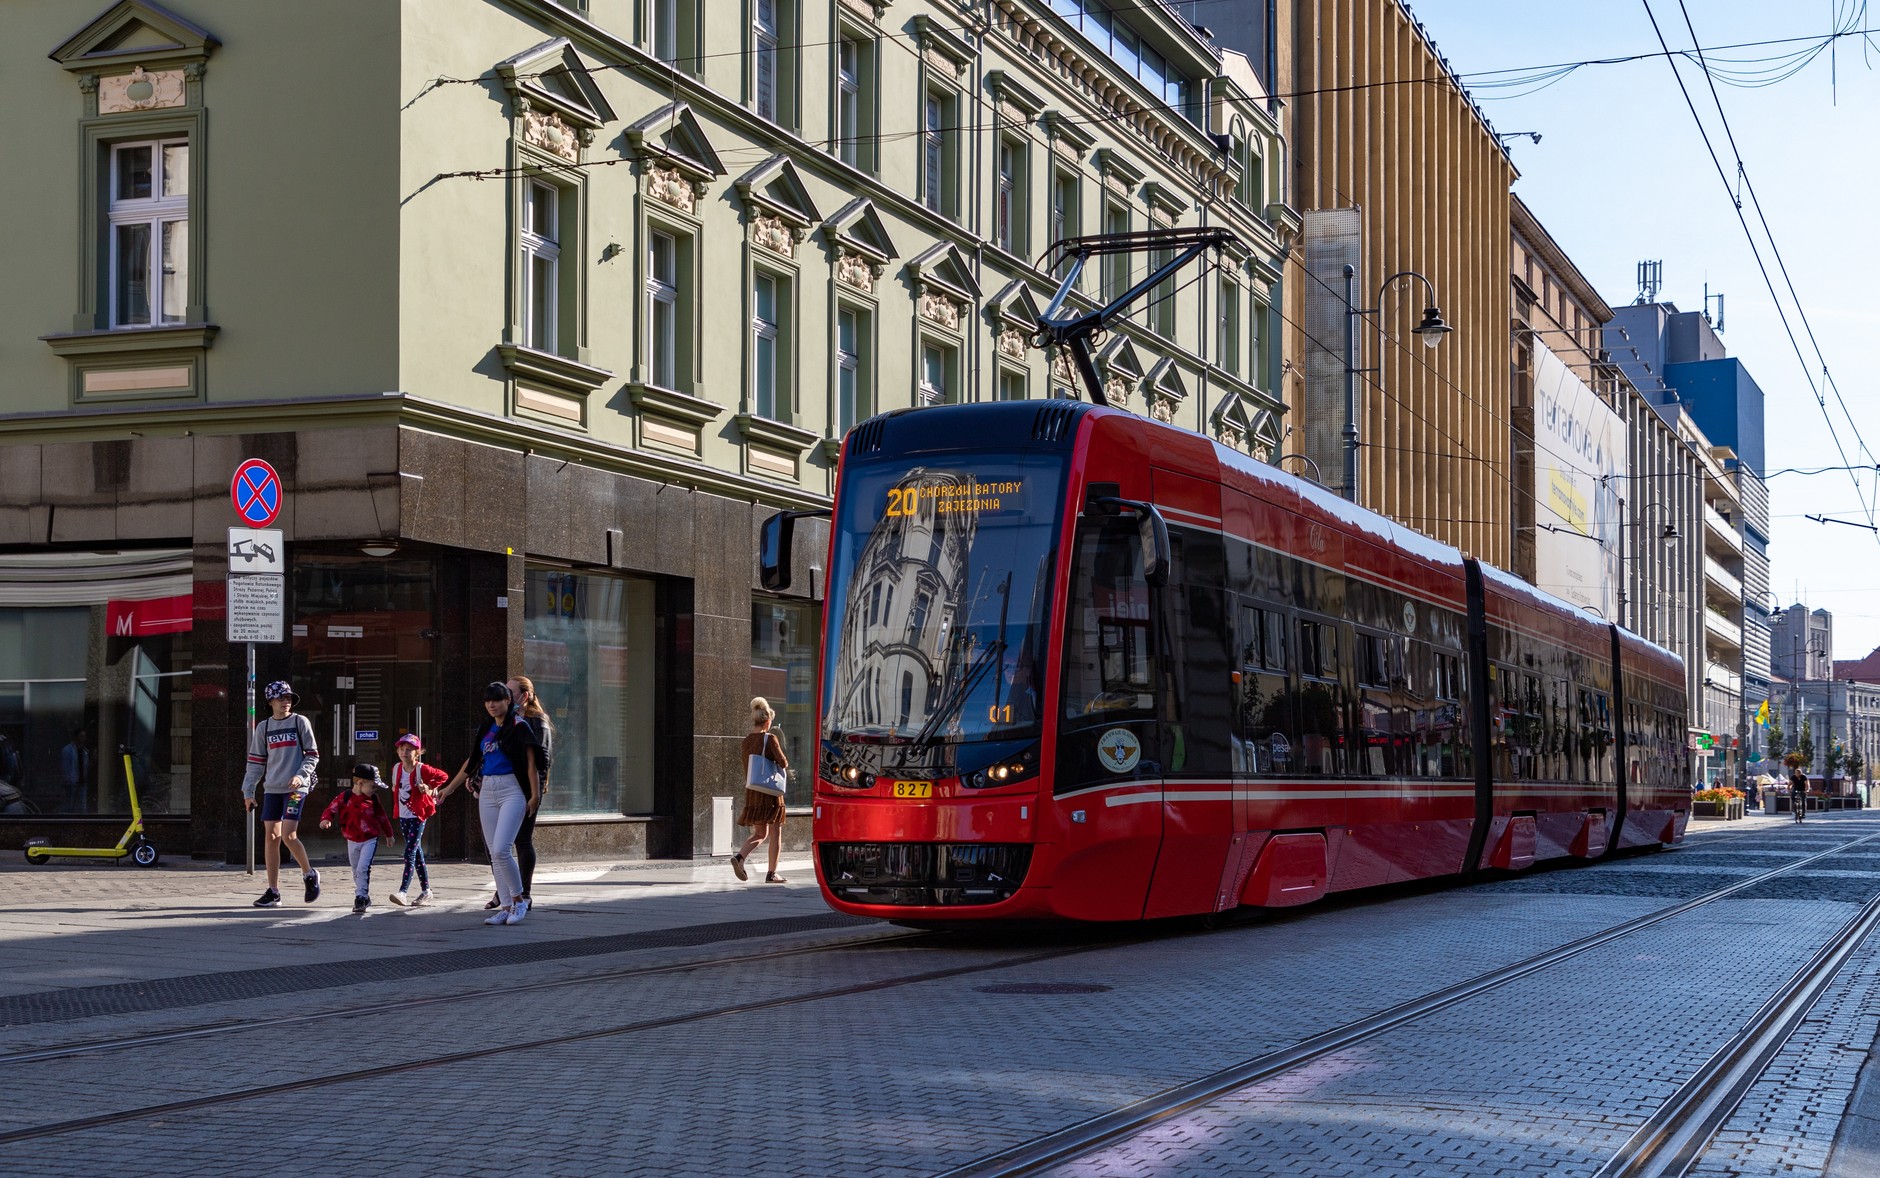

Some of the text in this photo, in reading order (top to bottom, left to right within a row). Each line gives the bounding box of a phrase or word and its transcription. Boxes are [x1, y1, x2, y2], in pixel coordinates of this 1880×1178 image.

[919, 481, 1022, 498] CHORZÓW BATORY
[886, 487, 917, 517] 20
[938, 498, 1000, 513] ZAJEZDNIA
[988, 704, 1011, 723] 01
[897, 782, 929, 796] 827
